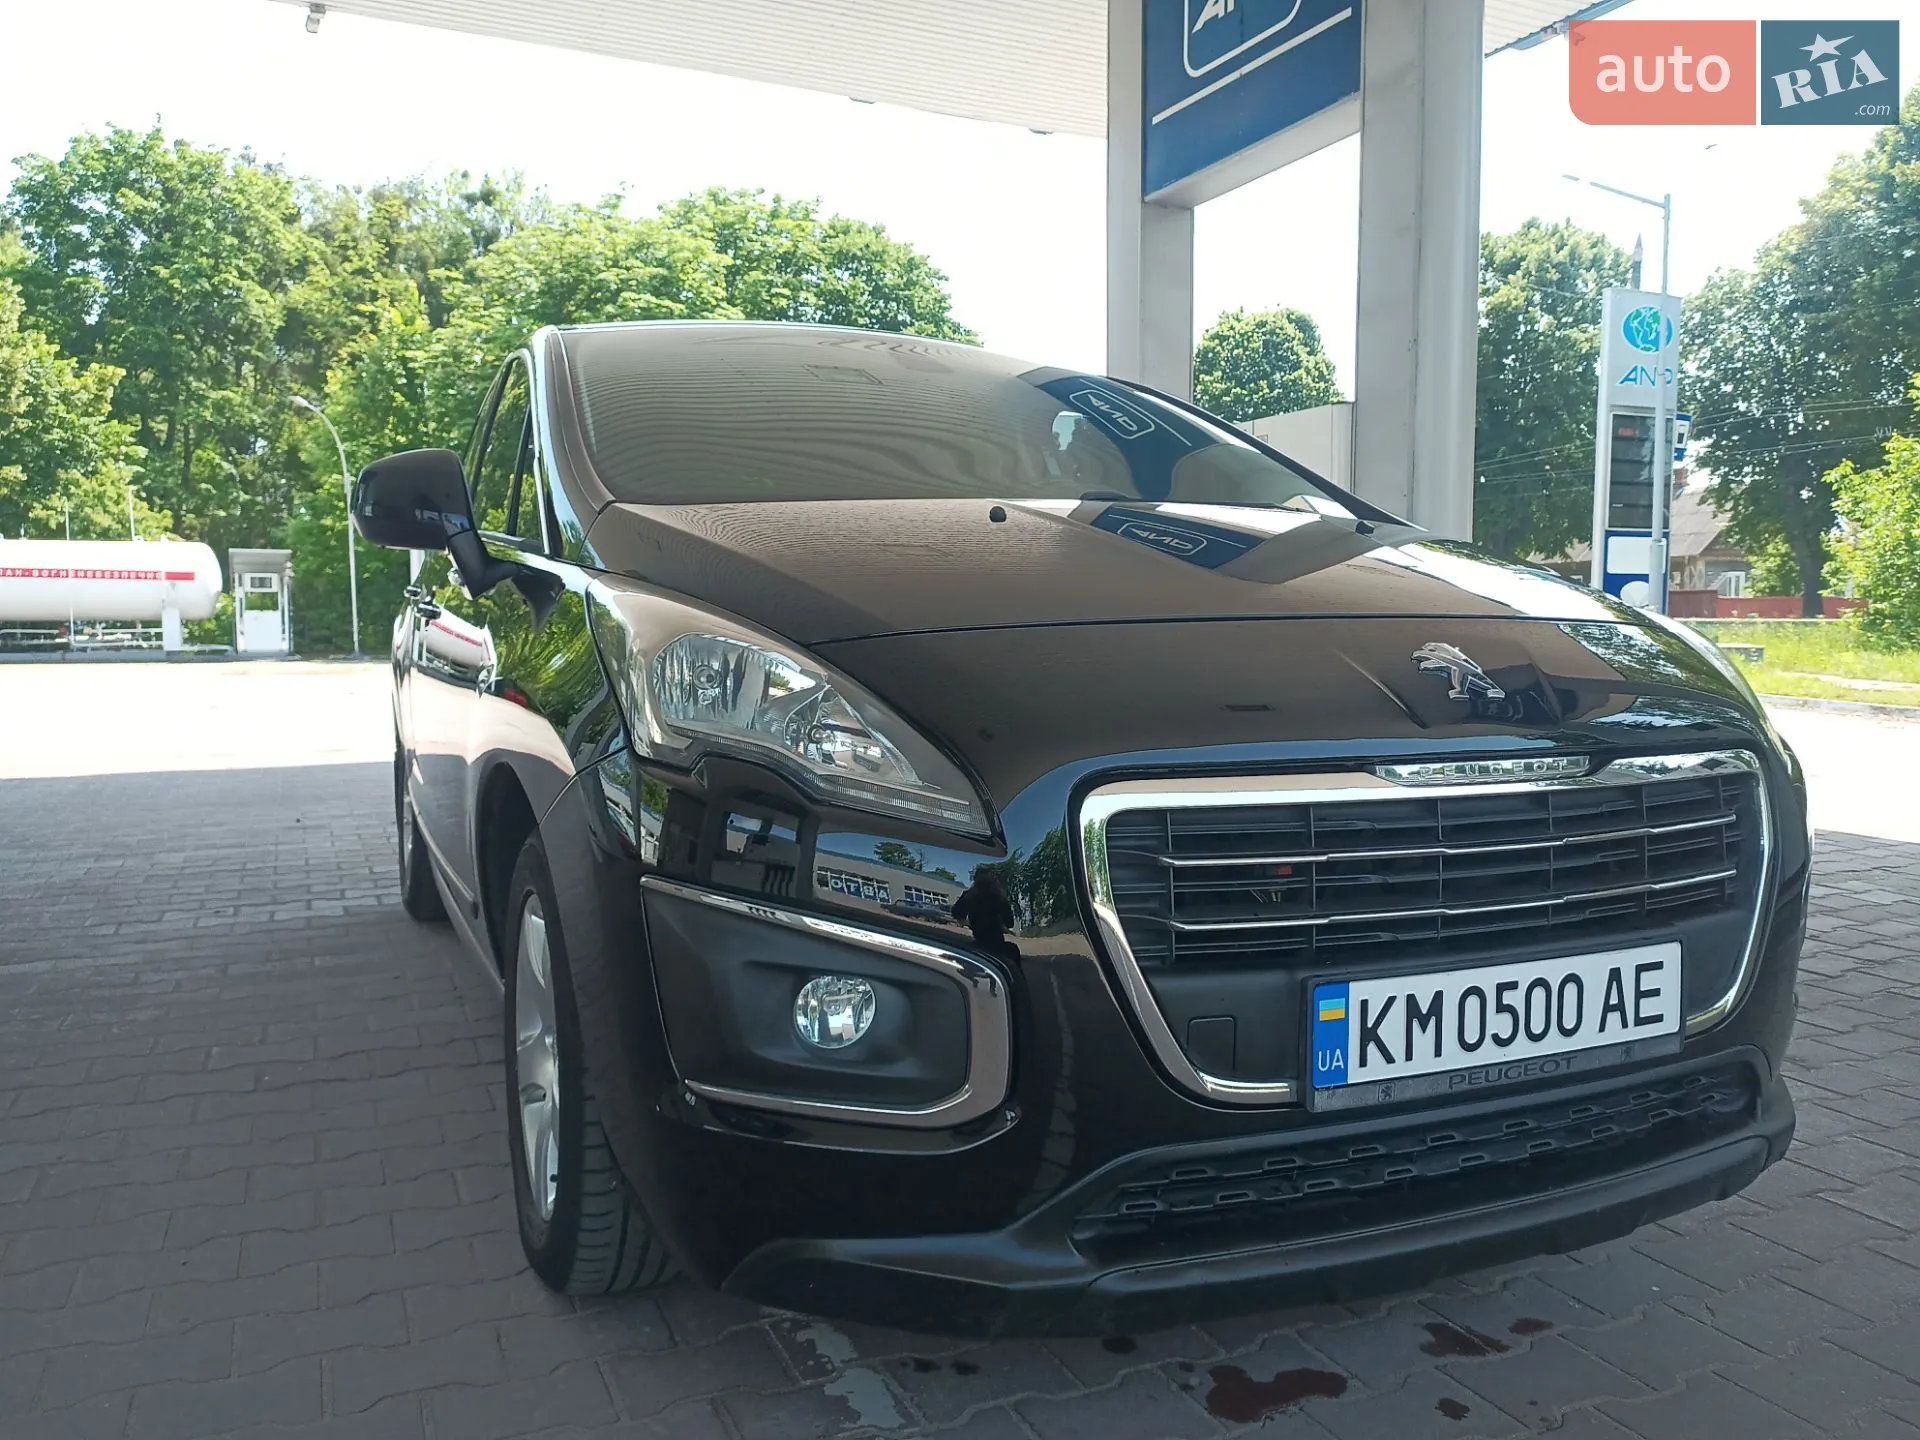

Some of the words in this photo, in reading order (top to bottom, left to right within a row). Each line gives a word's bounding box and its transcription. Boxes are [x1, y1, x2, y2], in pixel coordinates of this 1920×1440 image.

[1418, 758, 1567, 779] PEUGEOT
[1359, 988, 1444, 1068] KM
[1457, 971, 1585, 1053] 0500
[1598, 960, 1665, 1034] AE
[1318, 1048, 1345, 1072] UA
[1447, 1055, 1578, 1091] PEUGEOT
